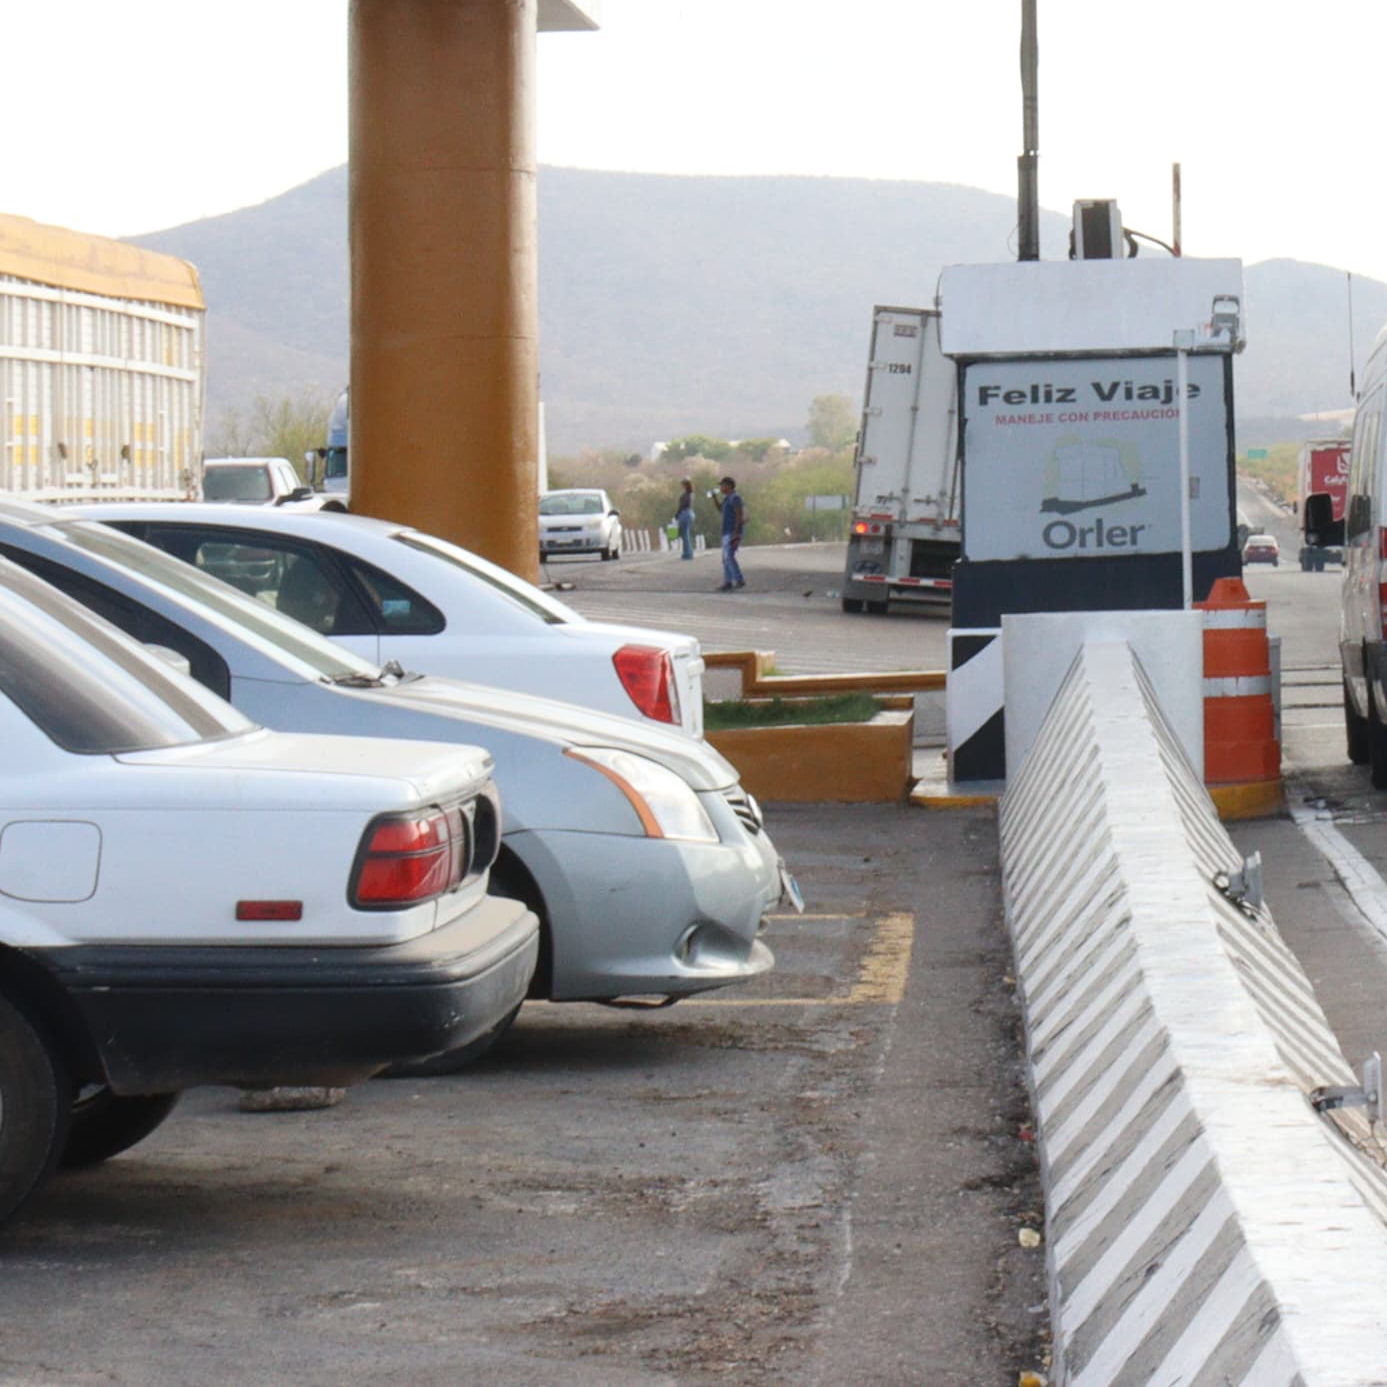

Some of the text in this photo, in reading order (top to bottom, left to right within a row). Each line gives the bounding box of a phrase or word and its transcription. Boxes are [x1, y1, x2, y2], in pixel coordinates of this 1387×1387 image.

[978, 379, 1201, 406] Feliz Viaje
[995, 413, 1053, 425] MANEJE
[1058, 411, 1089, 423] CON
[1042, 518, 1147, 549] Orler
